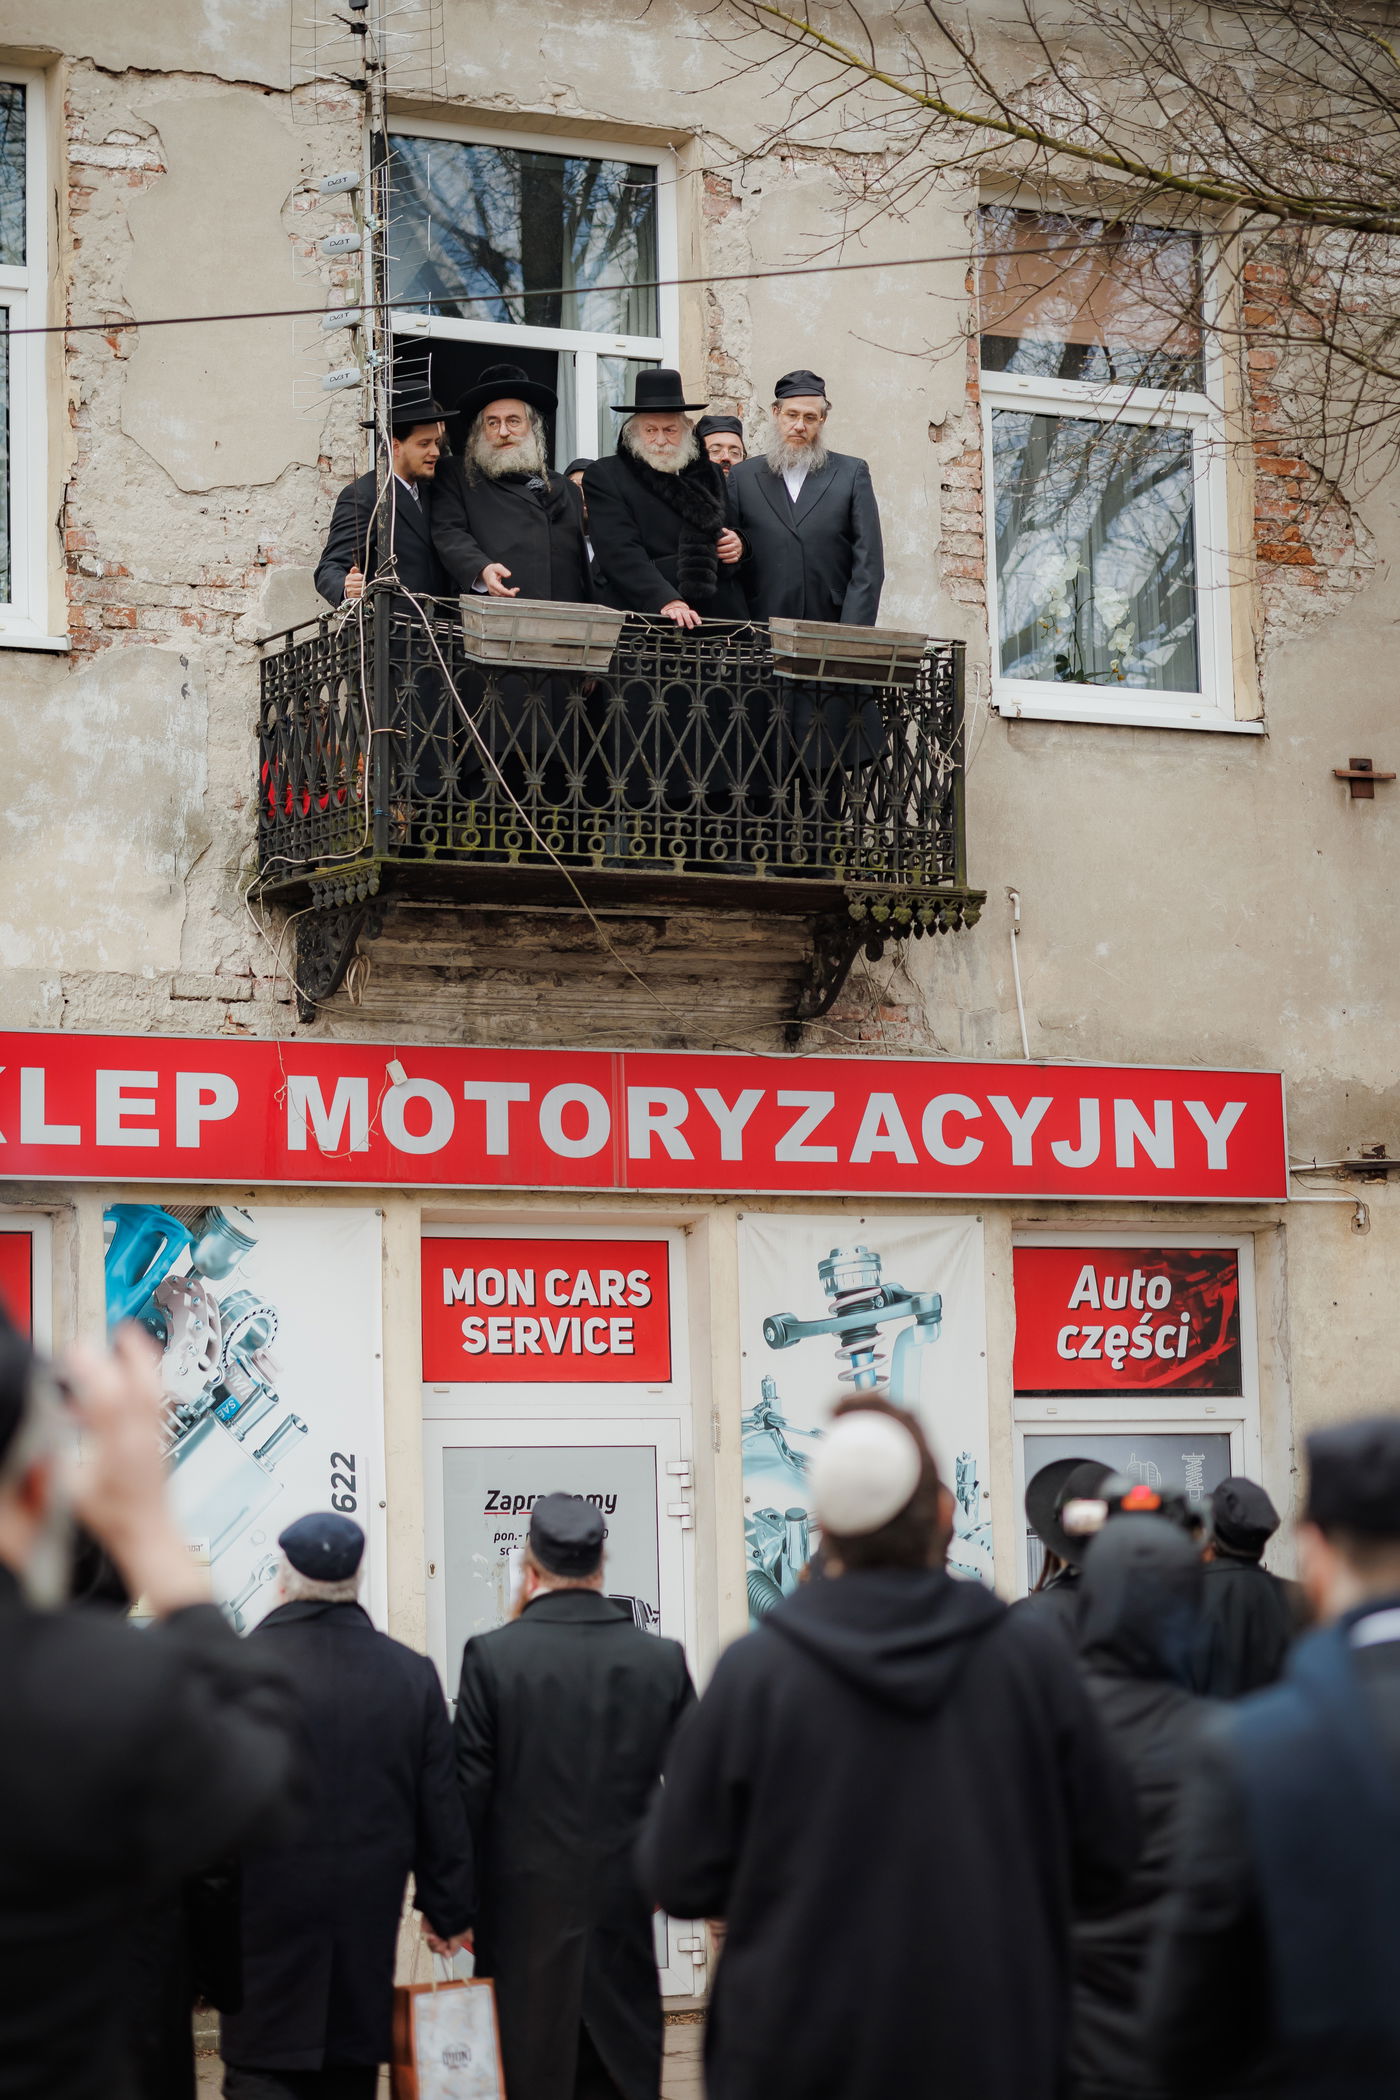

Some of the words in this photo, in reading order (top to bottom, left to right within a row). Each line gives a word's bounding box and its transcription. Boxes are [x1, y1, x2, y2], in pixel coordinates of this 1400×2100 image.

[0, 1066, 239, 1148] LEP
[287, 1074, 1248, 1170] MOTORYZACYJNY
[443, 1267, 536, 1306] MON
[545, 1268, 652, 1307] CARS
[1067, 1264, 1172, 1311] Auto
[461, 1316, 635, 1355] SERVICE
[1056, 1311, 1191, 1371] części
[330, 1451, 358, 1513] 622
